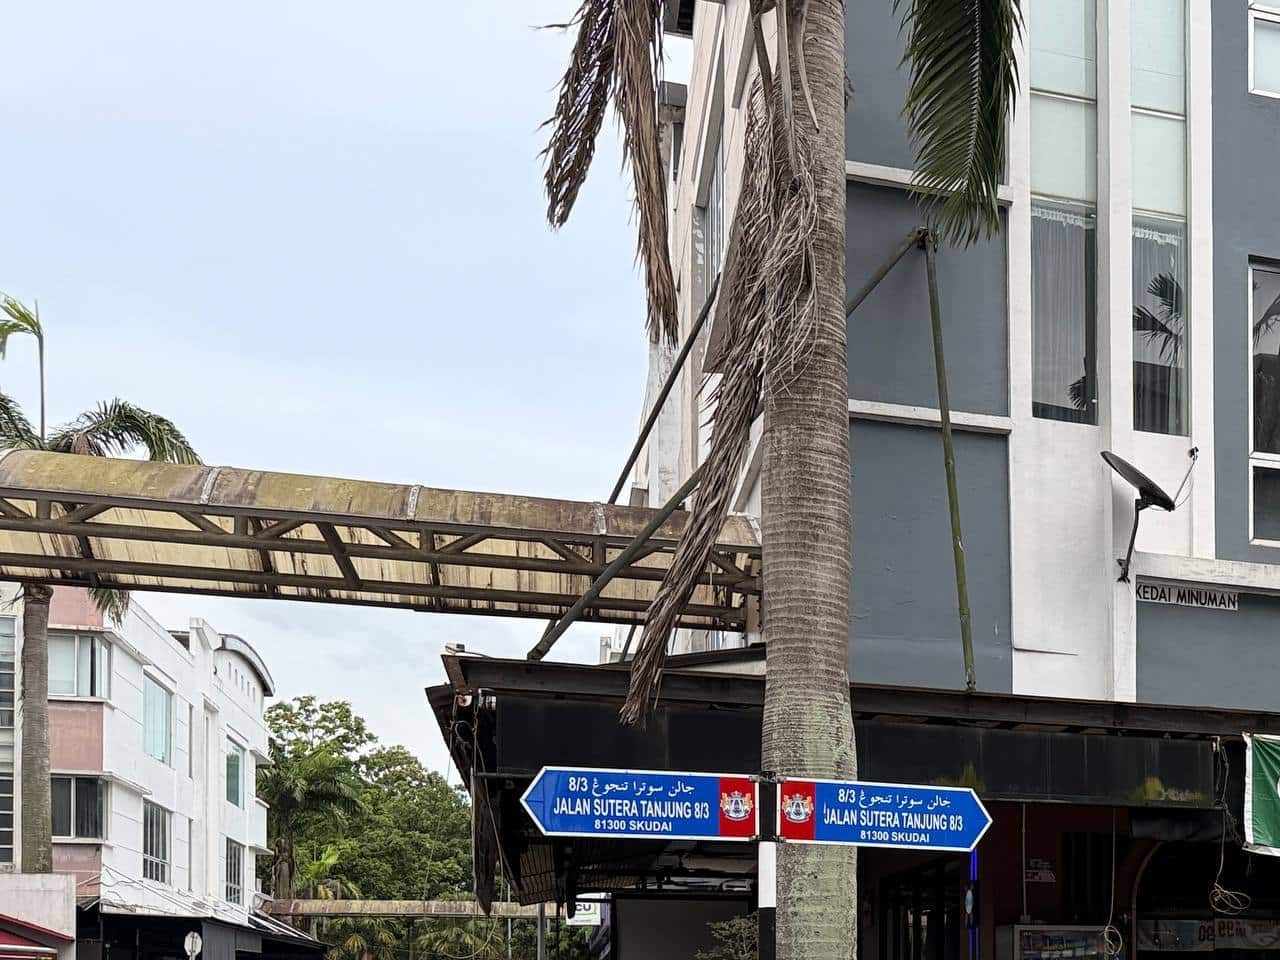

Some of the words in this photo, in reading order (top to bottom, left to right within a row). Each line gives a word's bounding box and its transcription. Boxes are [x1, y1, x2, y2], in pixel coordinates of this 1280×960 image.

[1136, 585, 1171, 602] KEDAI
[1176, 588, 1237, 608] MINUMAN
[568, 776, 588, 792] 8/3
[838, 788, 856, 803] 8/3
[553, 797, 591, 816] JALAN
[593, 799, 638, 817] SUTERA
[640, 800, 692, 819] TANJUNG
[694, 802, 710, 820] 8/3
[594, 819, 626, 830] 81300
[629, 820, 672, 832] SKUDAI
[823, 806, 857, 826] JALAN
[859, 809, 900, 828] SUTERA
[902, 811, 948, 831] TANJUNG
[949, 813, 963, 831] 8/3
[860, 830, 889, 841] 81300
[891, 830, 930, 843] SKUDAI
